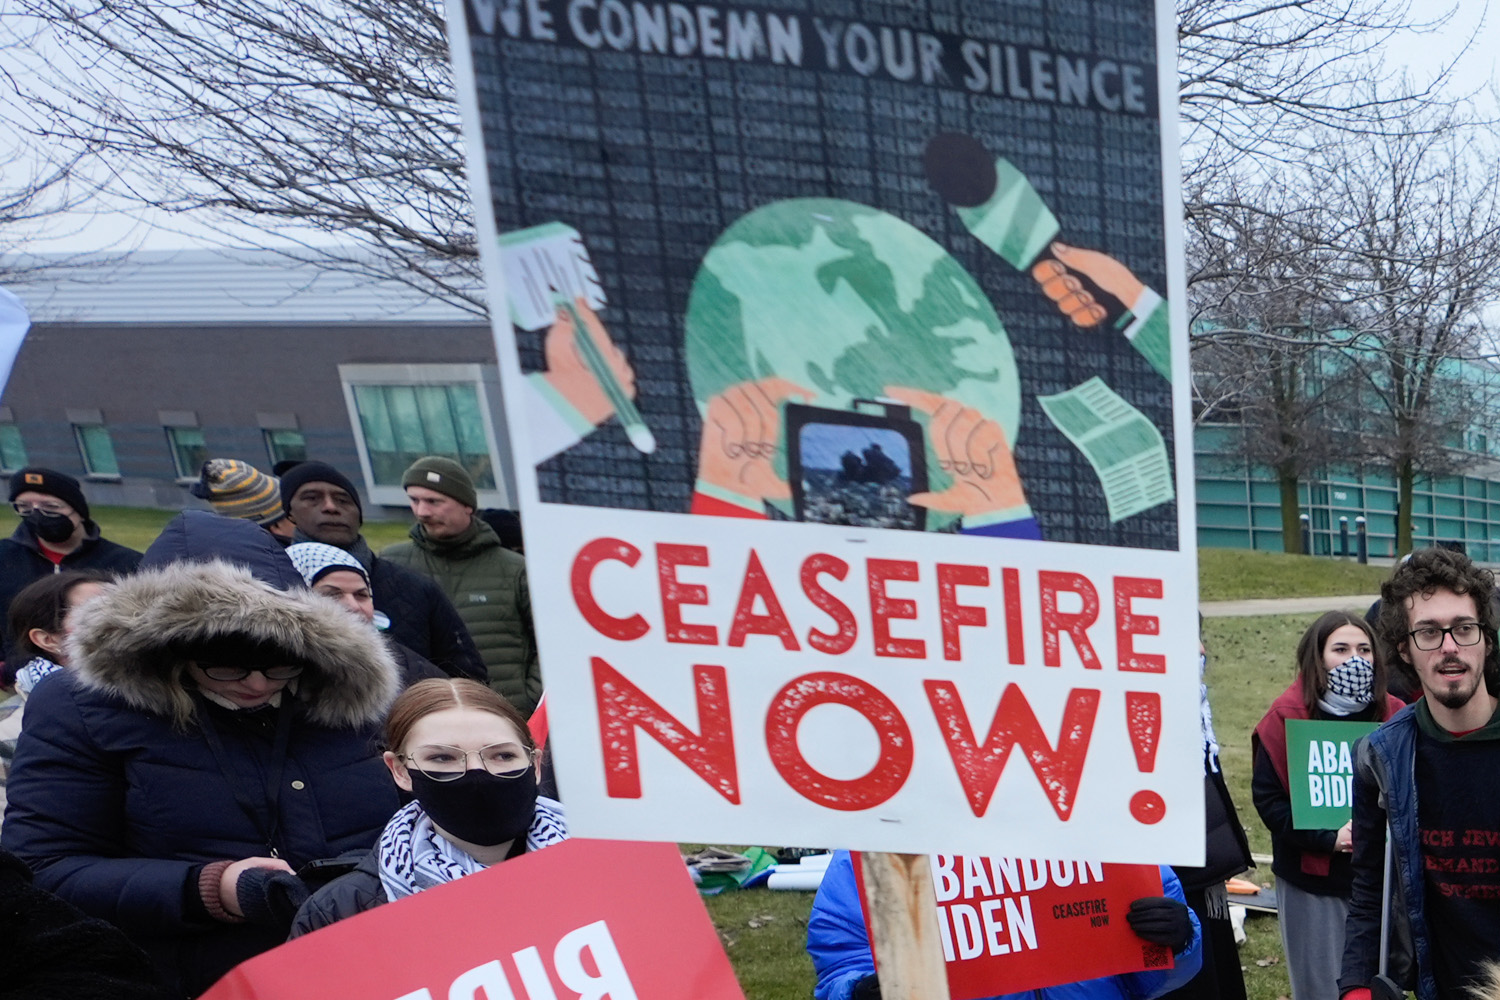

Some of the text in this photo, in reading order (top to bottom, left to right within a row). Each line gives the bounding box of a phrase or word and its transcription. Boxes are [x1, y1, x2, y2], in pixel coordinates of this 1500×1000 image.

[472, 0, 557, 41] WE
[568, 0, 803, 66] CONDEMN
[812, 17, 948, 85] YOUR
[962, 40, 1147, 113] SILENCE
[570, 536, 1167, 674] CEASEFIRE
[589, 655, 1167, 825] NOW!
[929, 854, 1104, 902] BANDON
[1052, 898, 1108, 921] CEASEFIRE
[937, 896, 1038, 962] IDEN
[1090, 914, 1110, 929] NOW
